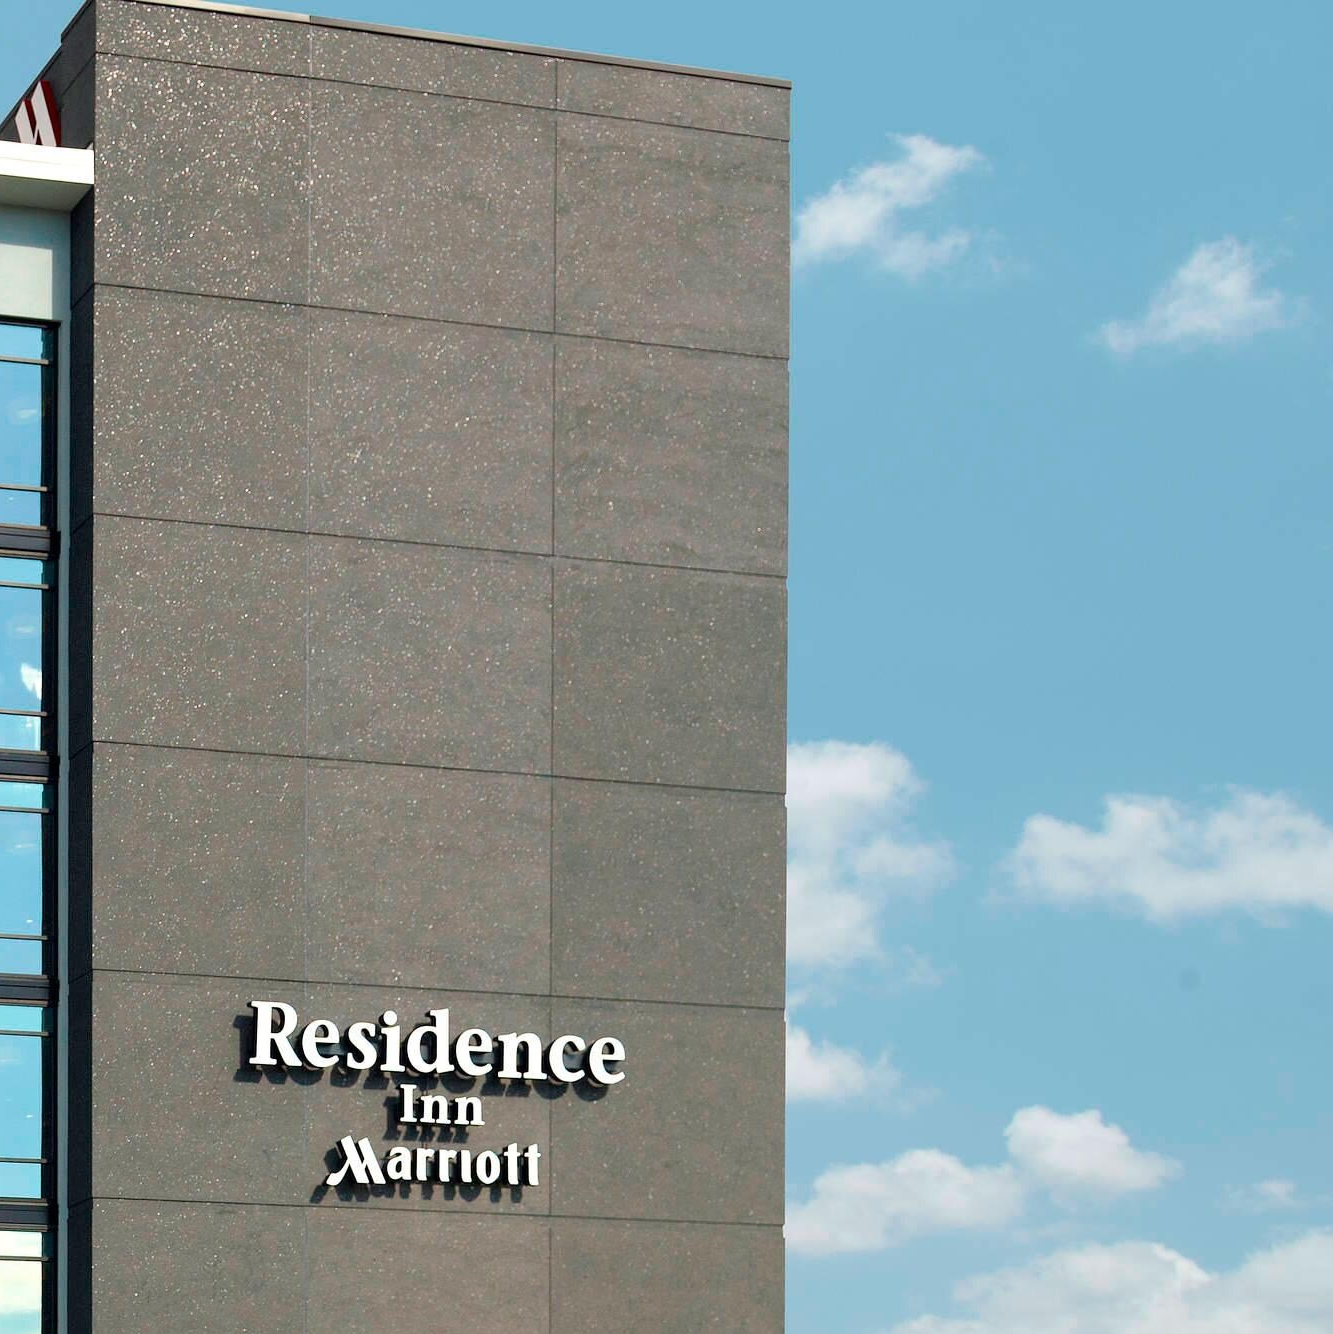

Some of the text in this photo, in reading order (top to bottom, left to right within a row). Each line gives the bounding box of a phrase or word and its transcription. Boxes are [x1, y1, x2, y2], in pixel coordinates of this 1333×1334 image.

[248, 1000, 626, 1085] Residence
[399, 1083, 486, 1126] Inn
[325, 1135, 542, 1187] Marriott
